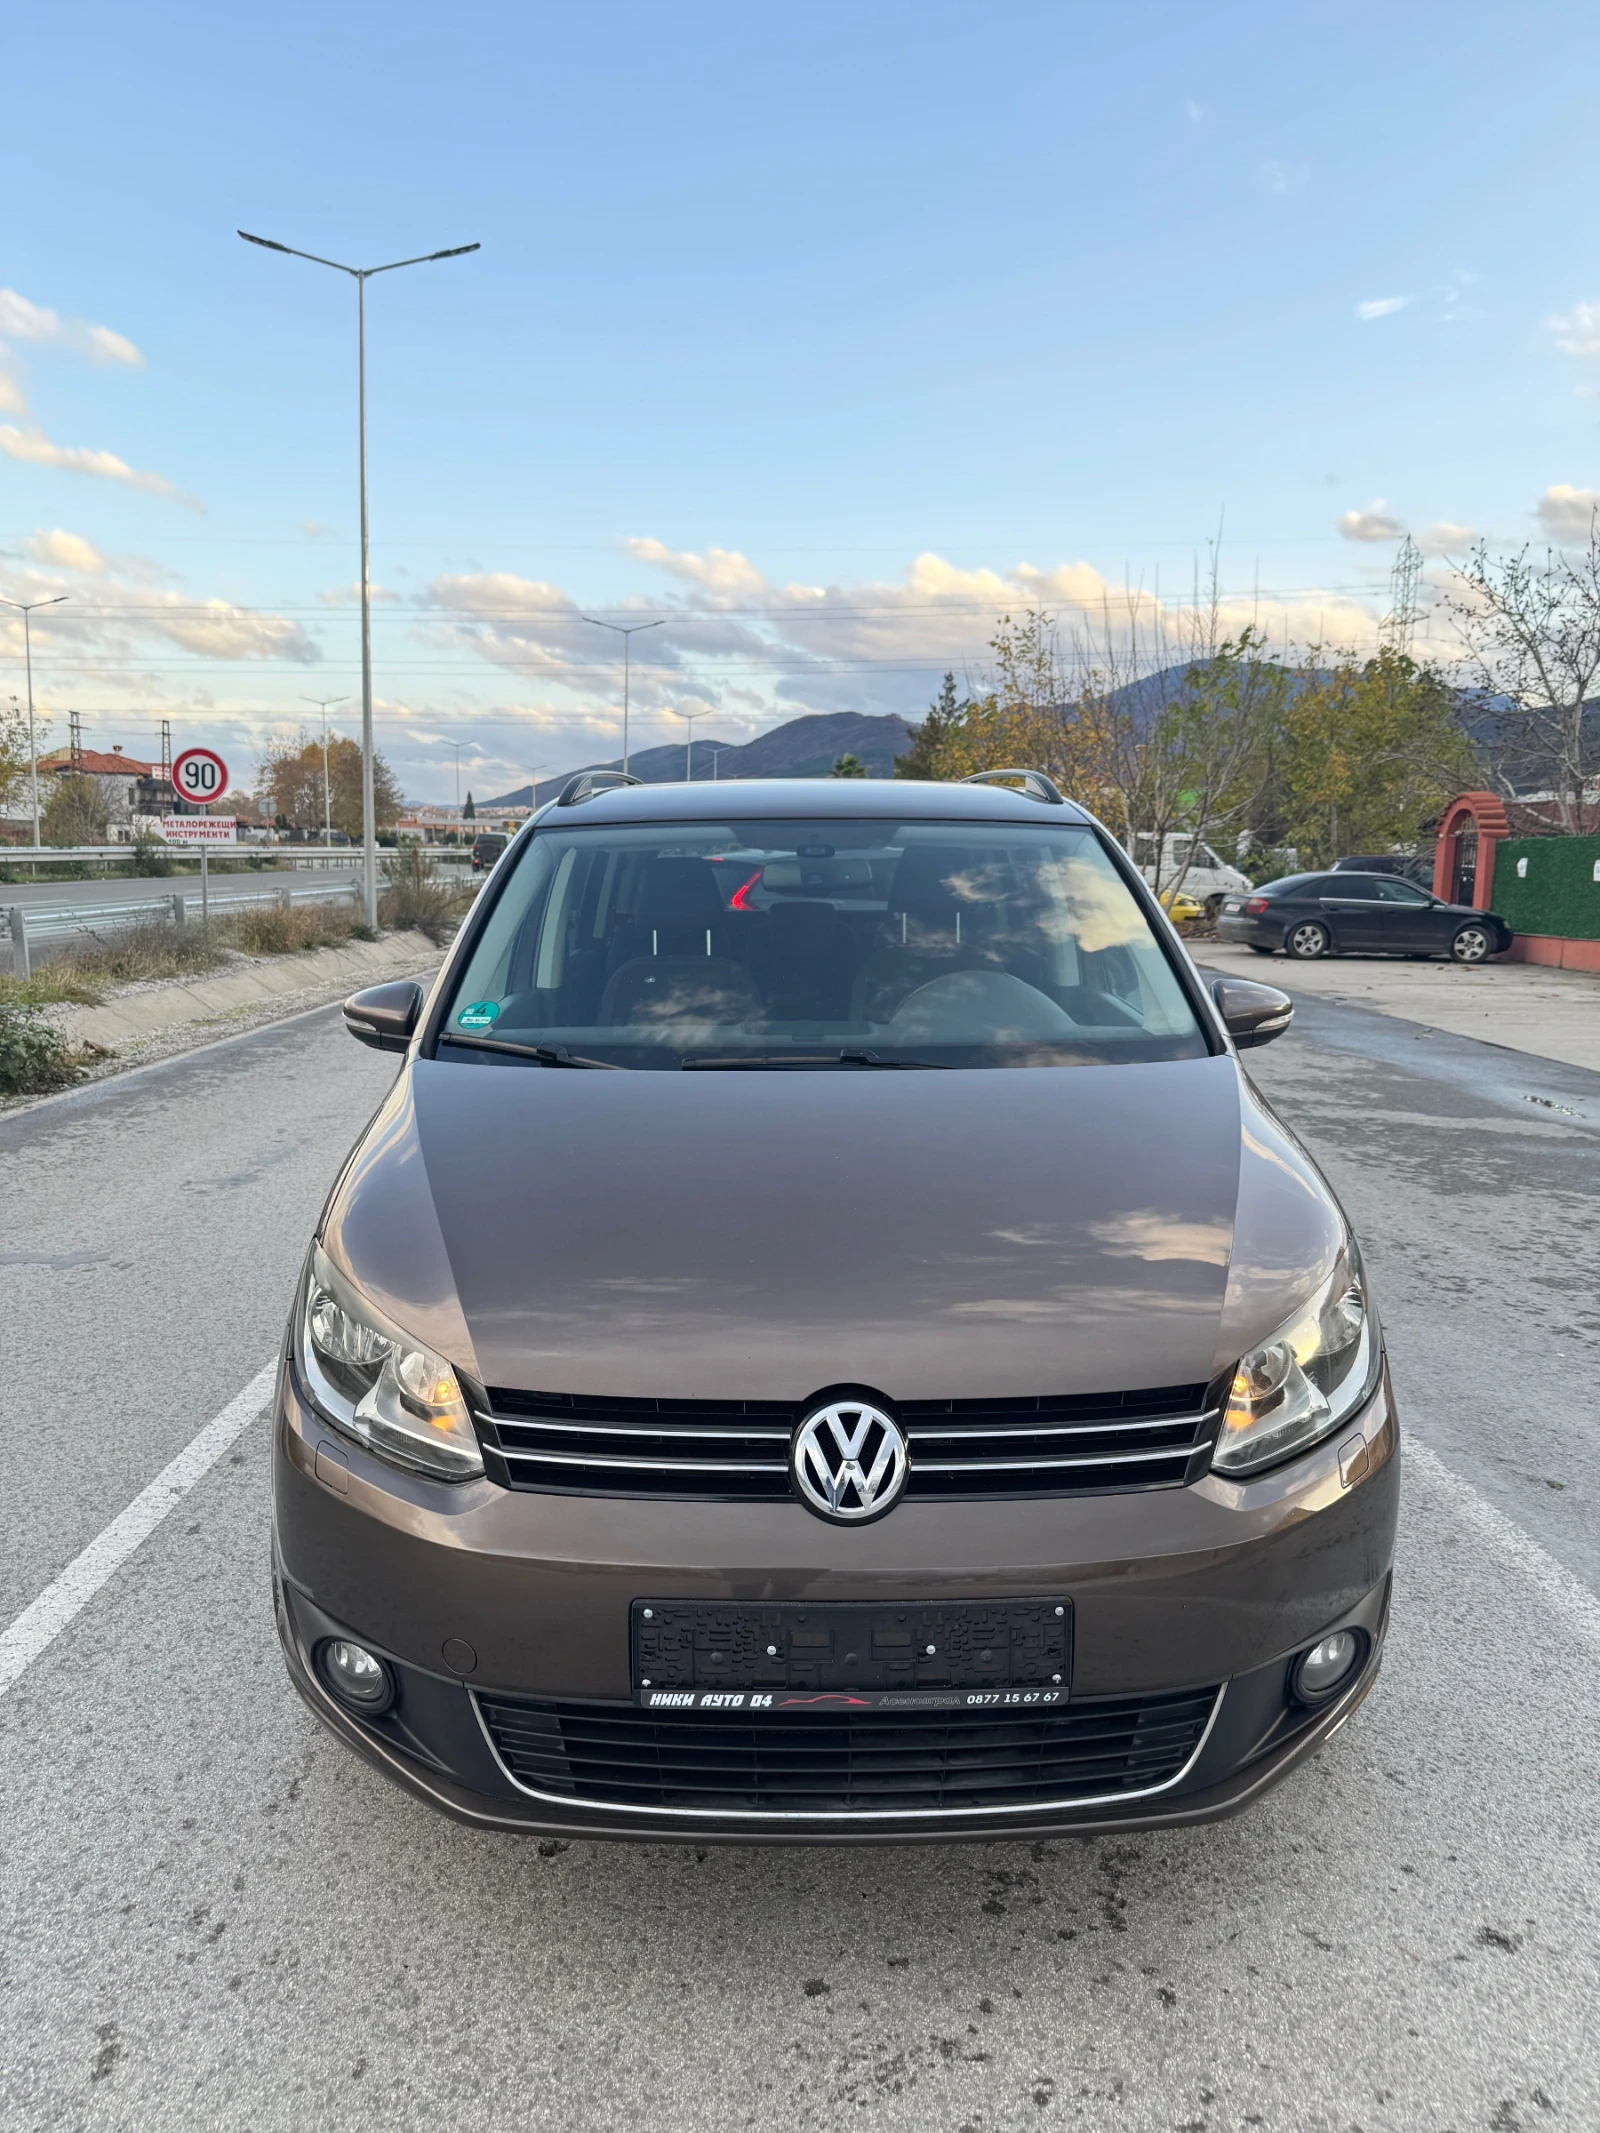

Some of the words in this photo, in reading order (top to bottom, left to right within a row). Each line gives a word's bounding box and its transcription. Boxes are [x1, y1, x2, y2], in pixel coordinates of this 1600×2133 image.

[185, 762, 216, 790] 90
[162, 820, 237, 830] МЕТАЛОРЕЖЕЩИ
[166, 830, 230, 839] ИНСТРУМЕНТИ
[475, 1002, 488, 1016] 4
[794, 1401, 906, 1519] VW
[649, 1693, 696, 1707] НИКИ
[700, 1694, 745, 1707] АУТО
[749, 1694, 773, 1707] 04
[966, 1694, 1000, 1705] 0877
[1003, 1693, 1020, 1703] 15
[1023, 1692, 1040, 1703] 67
[1043, 1692, 1060, 1702] 67
